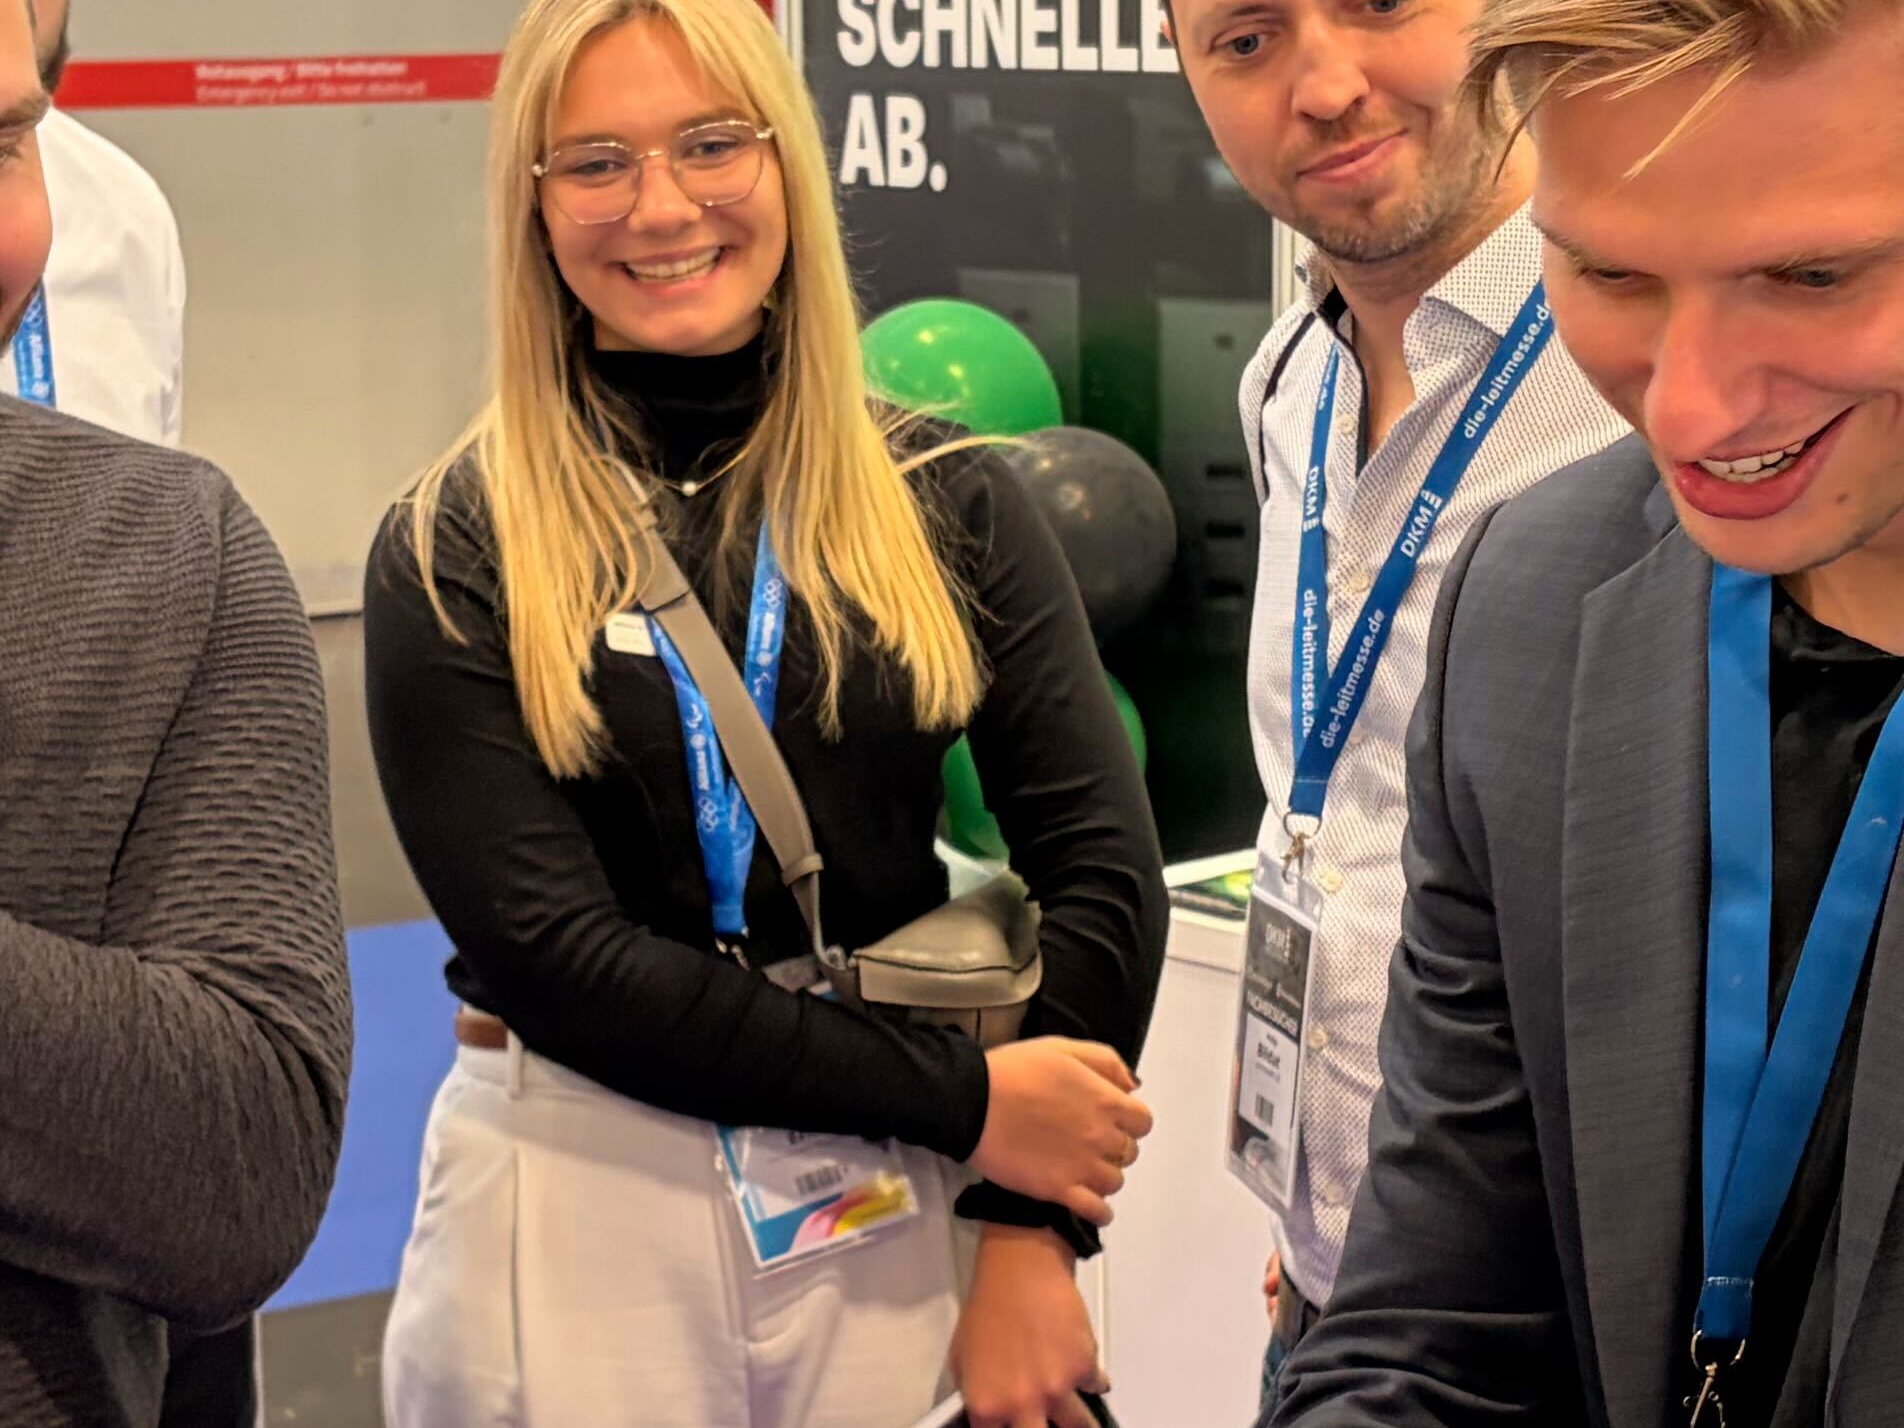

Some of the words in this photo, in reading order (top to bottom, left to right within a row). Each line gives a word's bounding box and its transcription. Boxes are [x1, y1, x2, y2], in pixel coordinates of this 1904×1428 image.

[839, 92, 948, 193] AB.
[1464, 304, 1550, 439] die-leitmesse.d
[1400, 505, 1434, 558] DKM
[1320, 608, 1385, 749] die-leitmesse.de
